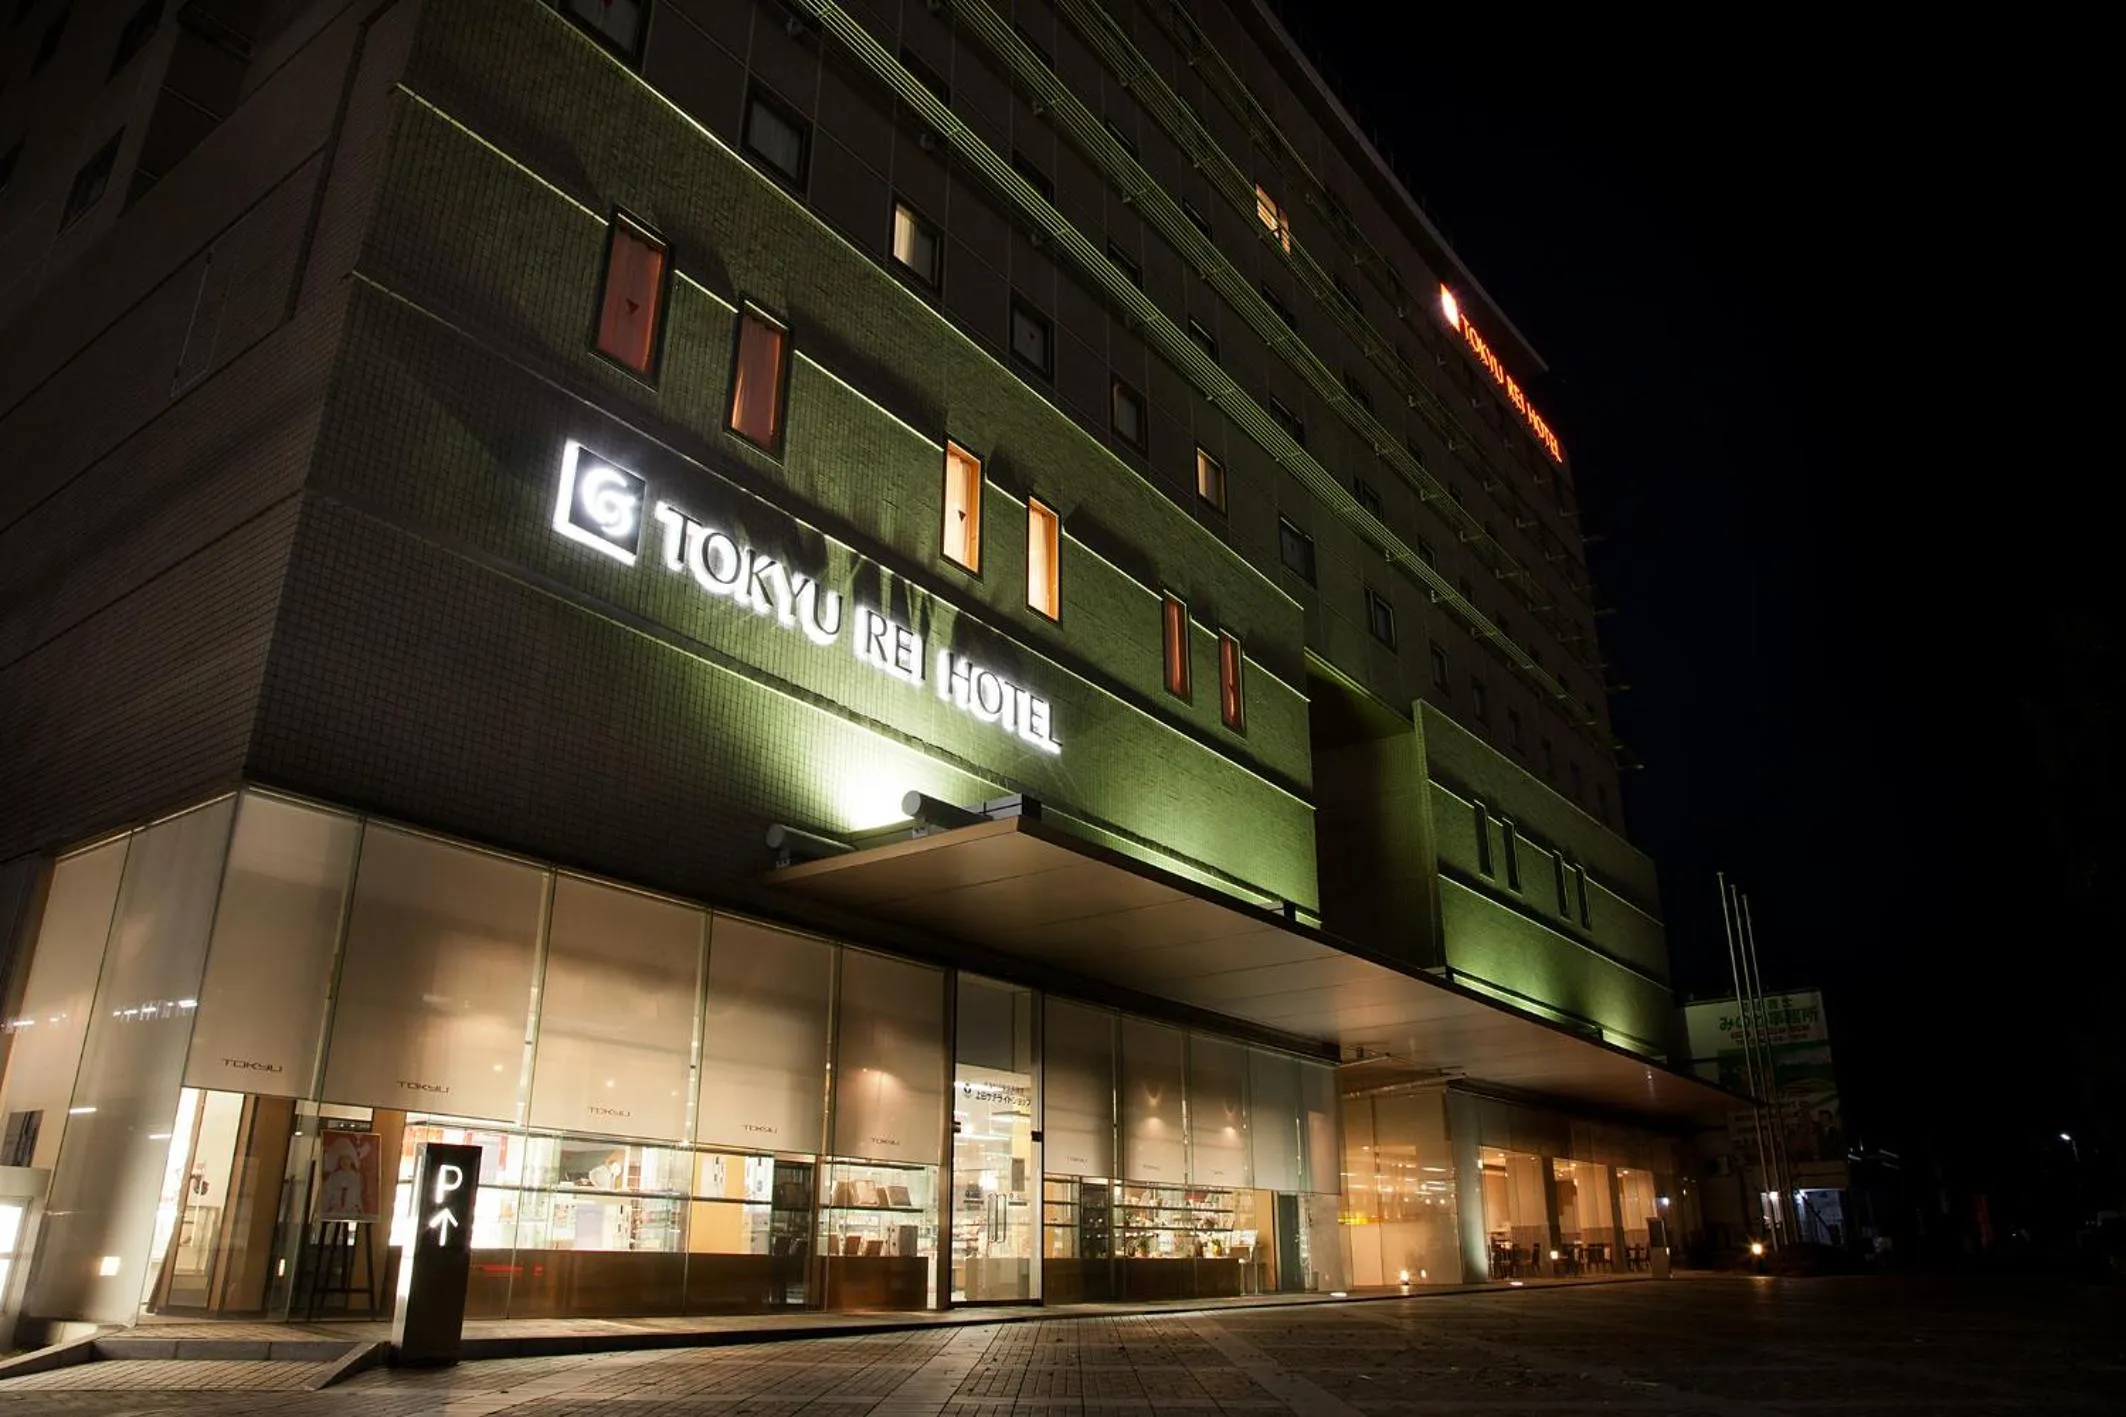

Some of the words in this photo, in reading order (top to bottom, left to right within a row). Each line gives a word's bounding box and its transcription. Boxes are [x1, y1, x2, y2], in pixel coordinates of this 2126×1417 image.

[1460, 313, 1504, 384] TOKYU
[1506, 375, 1525, 415] REI
[1527, 402, 1562, 463] HOTEL
[656, 501, 842, 644] TOKYU
[854, 606, 926, 688] REI
[938, 650, 1063, 753] HOTEL
[222, 1058, 282, 1073] TOKYU
[397, 1080, 449, 1094] TOKYU
[588, 1106, 630, 1117] TOKYU
[743, 1124, 778, 1134] TOKYU
[435, 1164, 462, 1204] P
